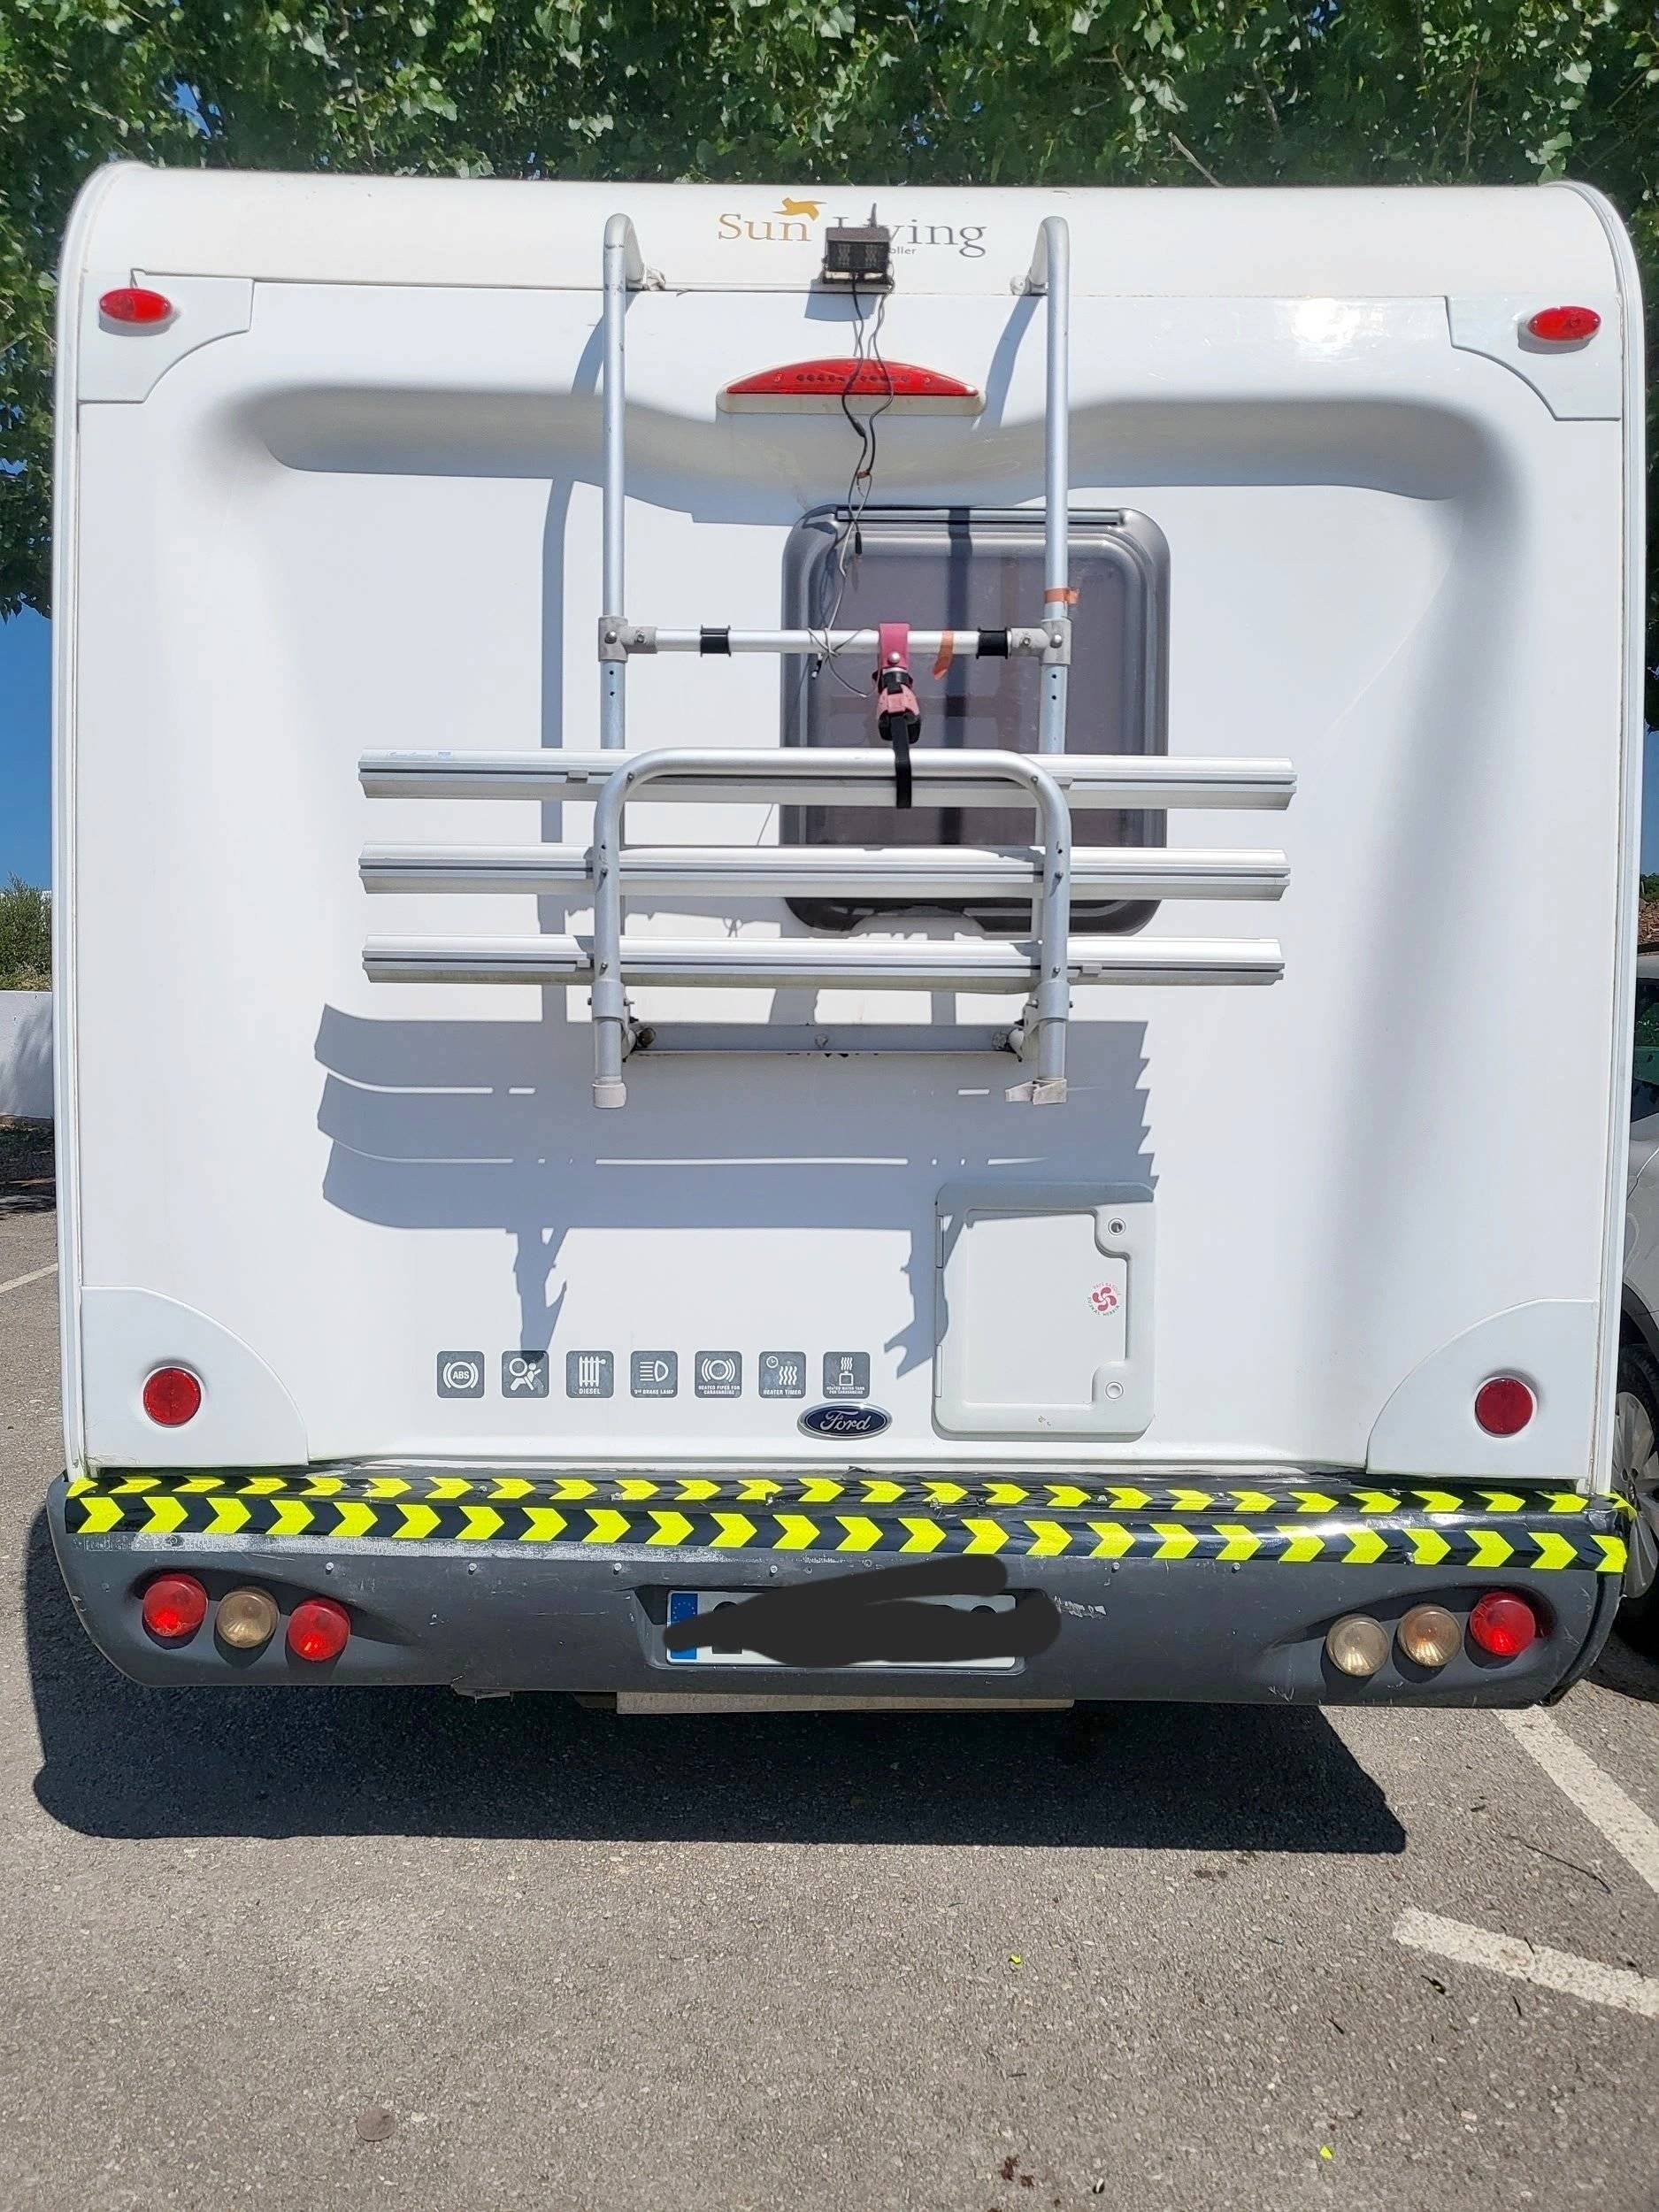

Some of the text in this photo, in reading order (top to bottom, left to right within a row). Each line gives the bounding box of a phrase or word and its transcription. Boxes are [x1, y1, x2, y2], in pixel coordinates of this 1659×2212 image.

[718, 213, 987, 258] Sun ving
[452, 1371, 470, 1379] ABS
[819, 1409, 872, 1431] Ford
